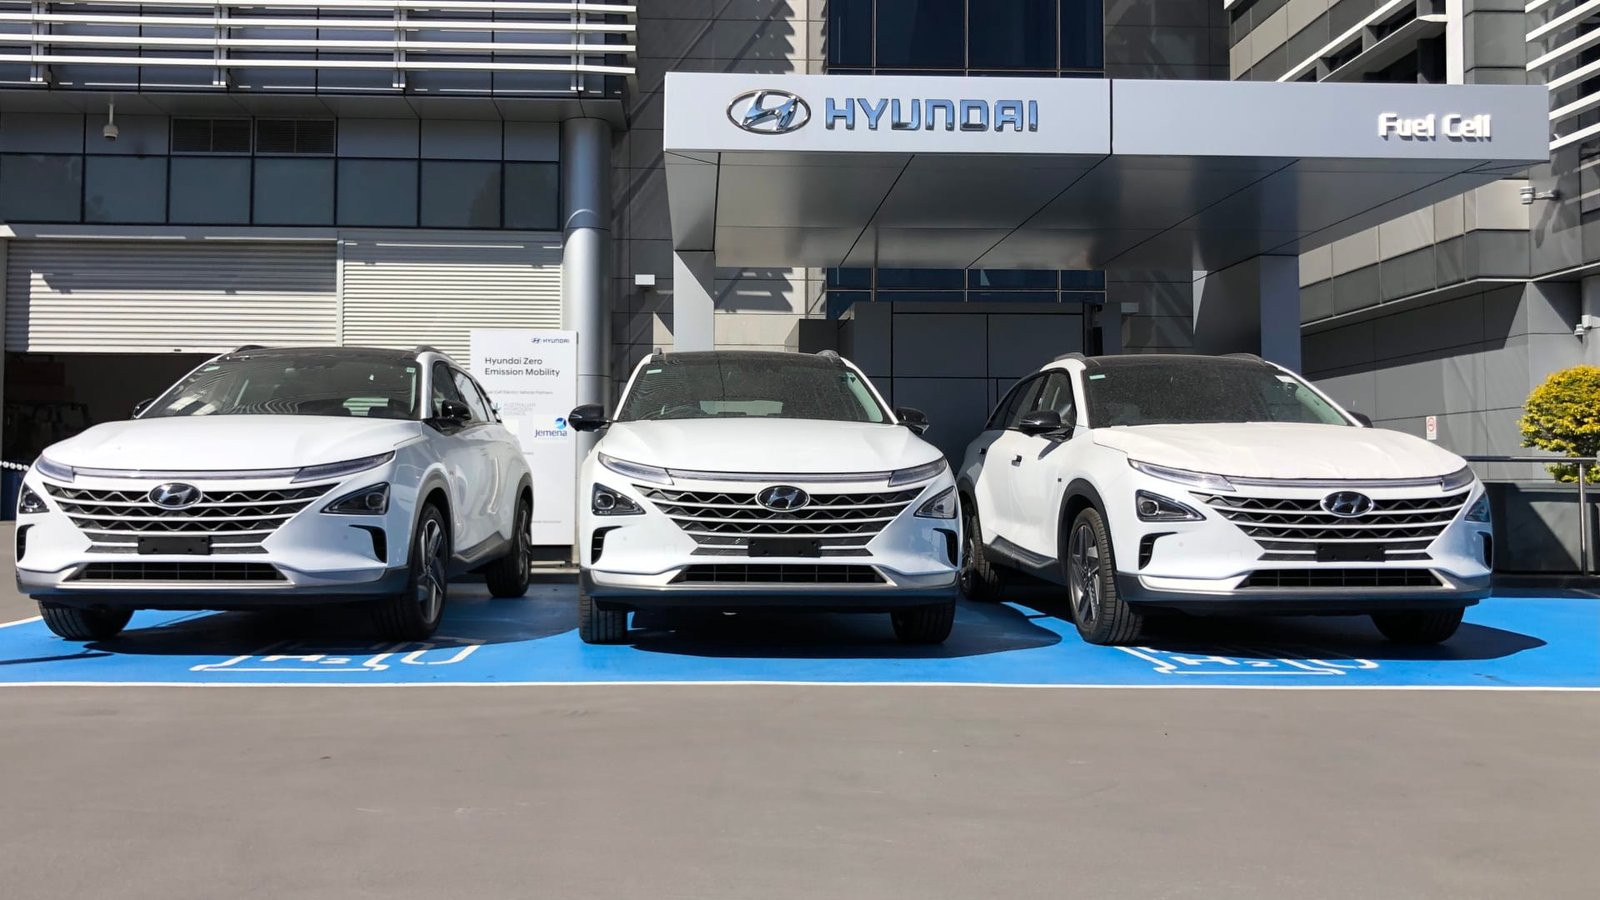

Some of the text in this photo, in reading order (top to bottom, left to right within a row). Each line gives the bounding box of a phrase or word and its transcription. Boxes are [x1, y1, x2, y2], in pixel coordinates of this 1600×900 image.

[825, 97, 1038, 131] HYUNDAI
[1378, 112, 1491, 140] Fuel Cell
[484, 356, 543, 366] Hyundai Zero
[484, 367, 561, 378] Emission Mobility
